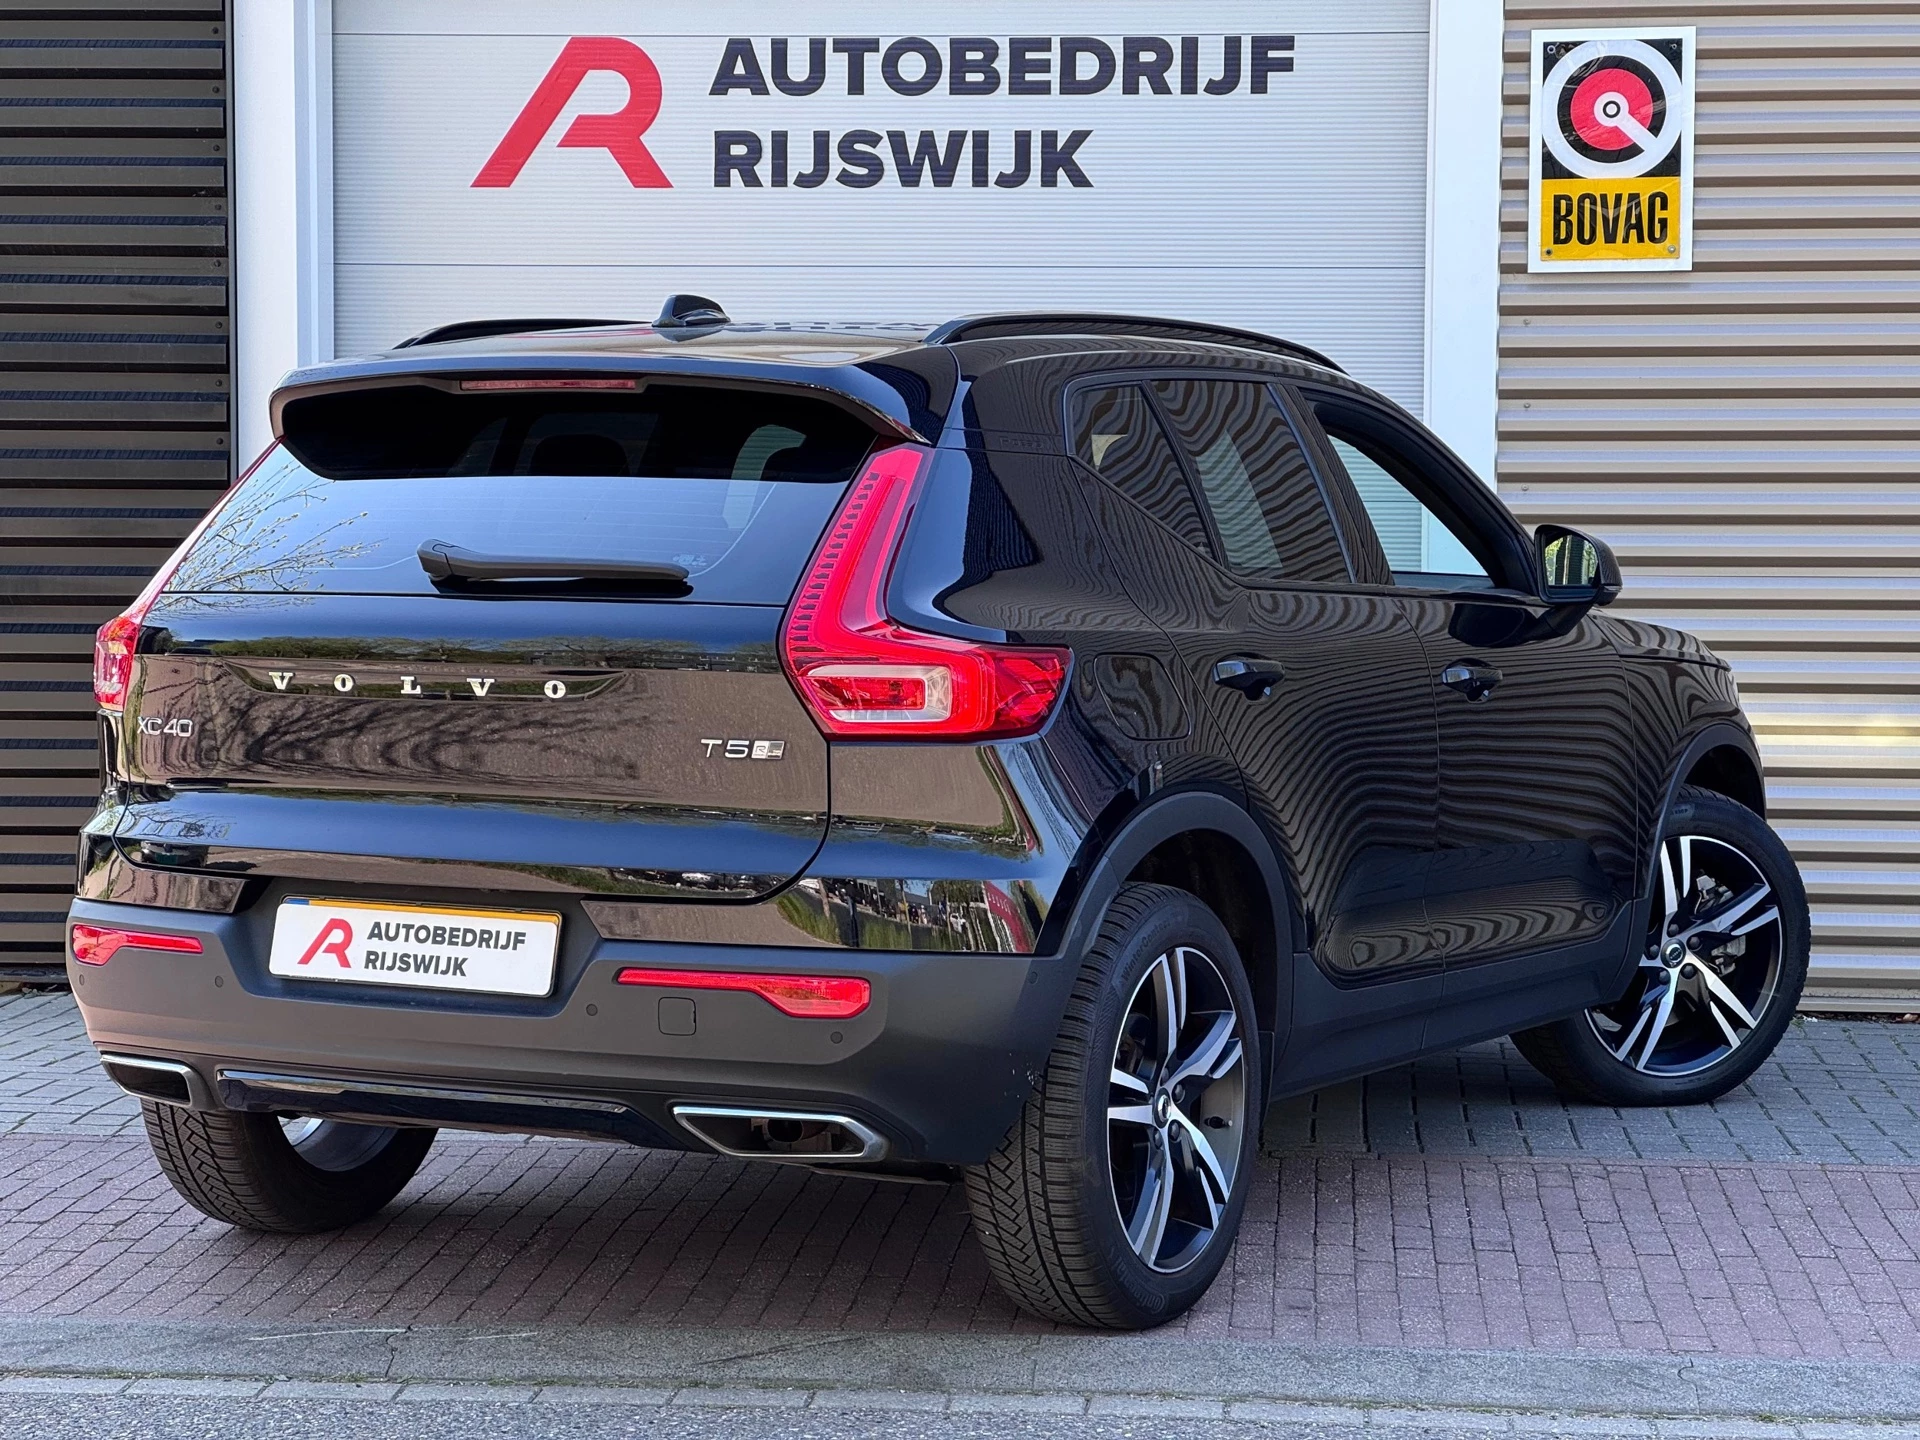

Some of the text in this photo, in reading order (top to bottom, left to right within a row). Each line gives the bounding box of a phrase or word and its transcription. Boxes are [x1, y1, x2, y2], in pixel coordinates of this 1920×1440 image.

[709, 35, 1295, 96] AUTOBEDRIJF
[713, 129, 1094, 188] RIJSWIJK
[1552, 191, 1669, 245] BOVAG
[268, 671, 567, 699] VOLVO
[137, 716, 194, 737] XC40
[700, 738, 750, 758] T5
[367, 921, 527, 951] AUTOBEDRIJF
[364, 950, 468, 977] RIJSWIJK
